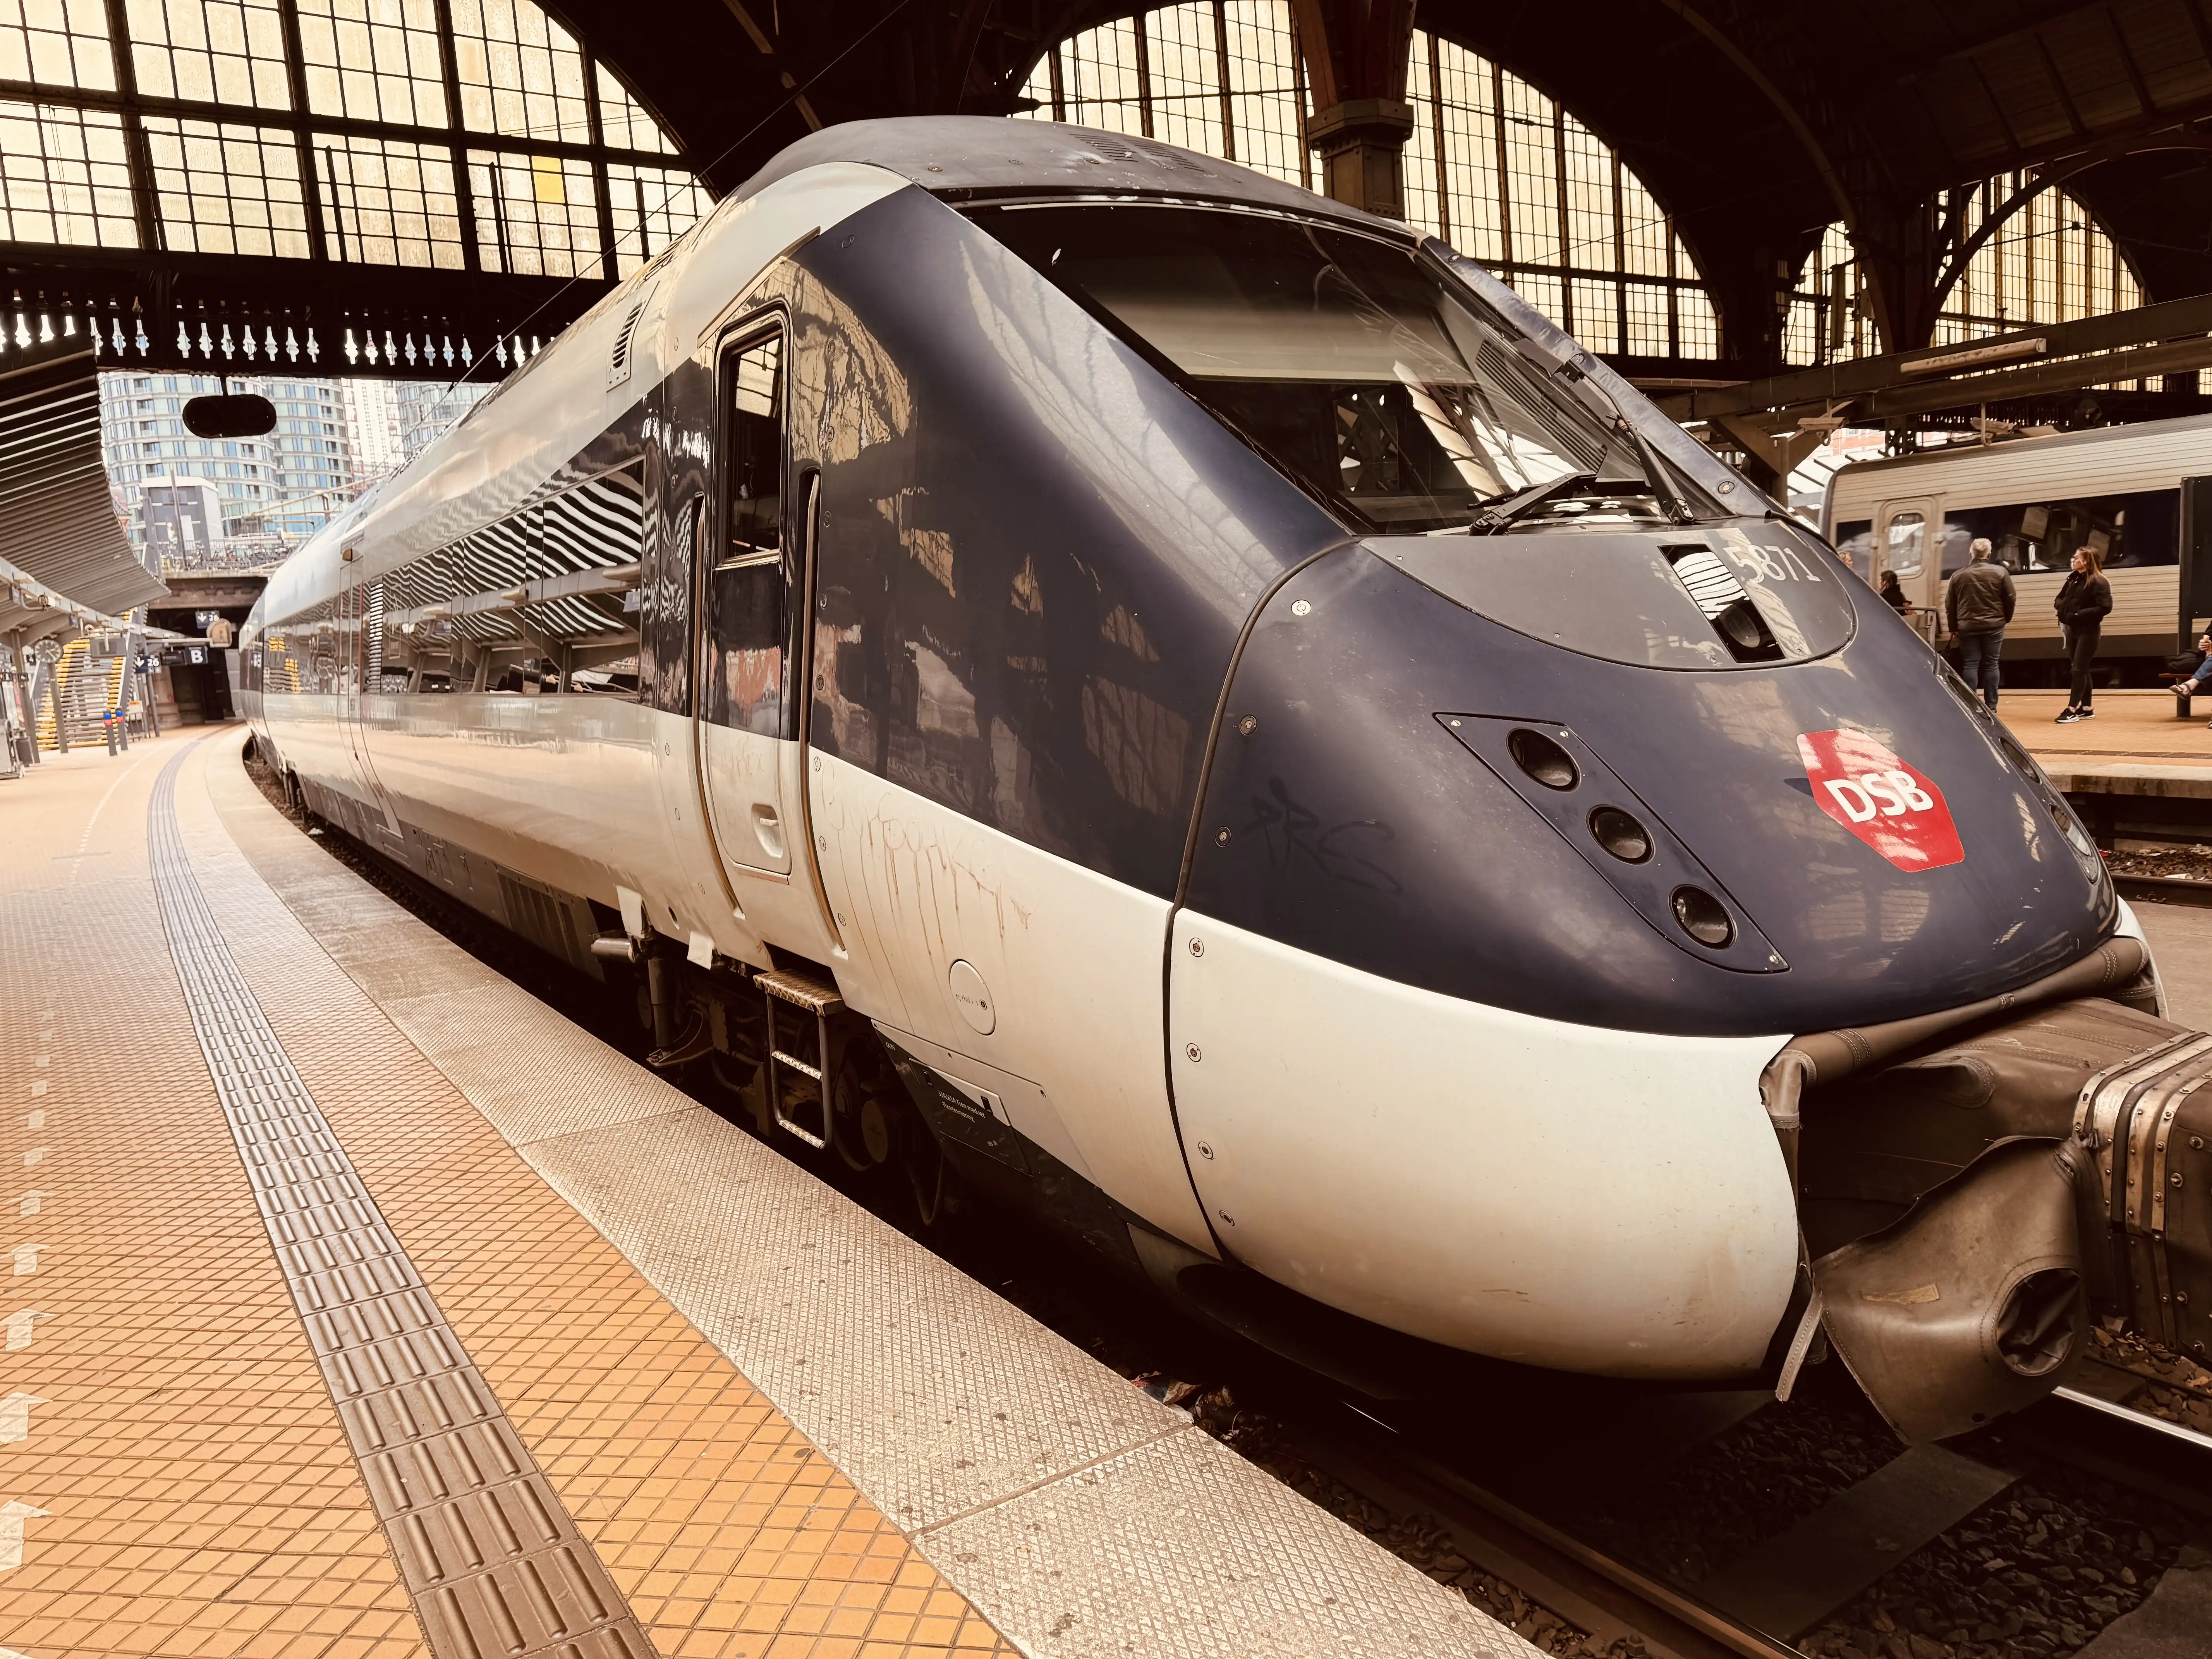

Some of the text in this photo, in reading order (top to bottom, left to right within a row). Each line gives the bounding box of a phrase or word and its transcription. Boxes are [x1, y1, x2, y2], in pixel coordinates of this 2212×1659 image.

[1723, 544, 1822, 584] 5871
[147, 658, 160, 667] 26
[191, 649, 203, 664] B
[1822, 770, 1934, 823] DSB
